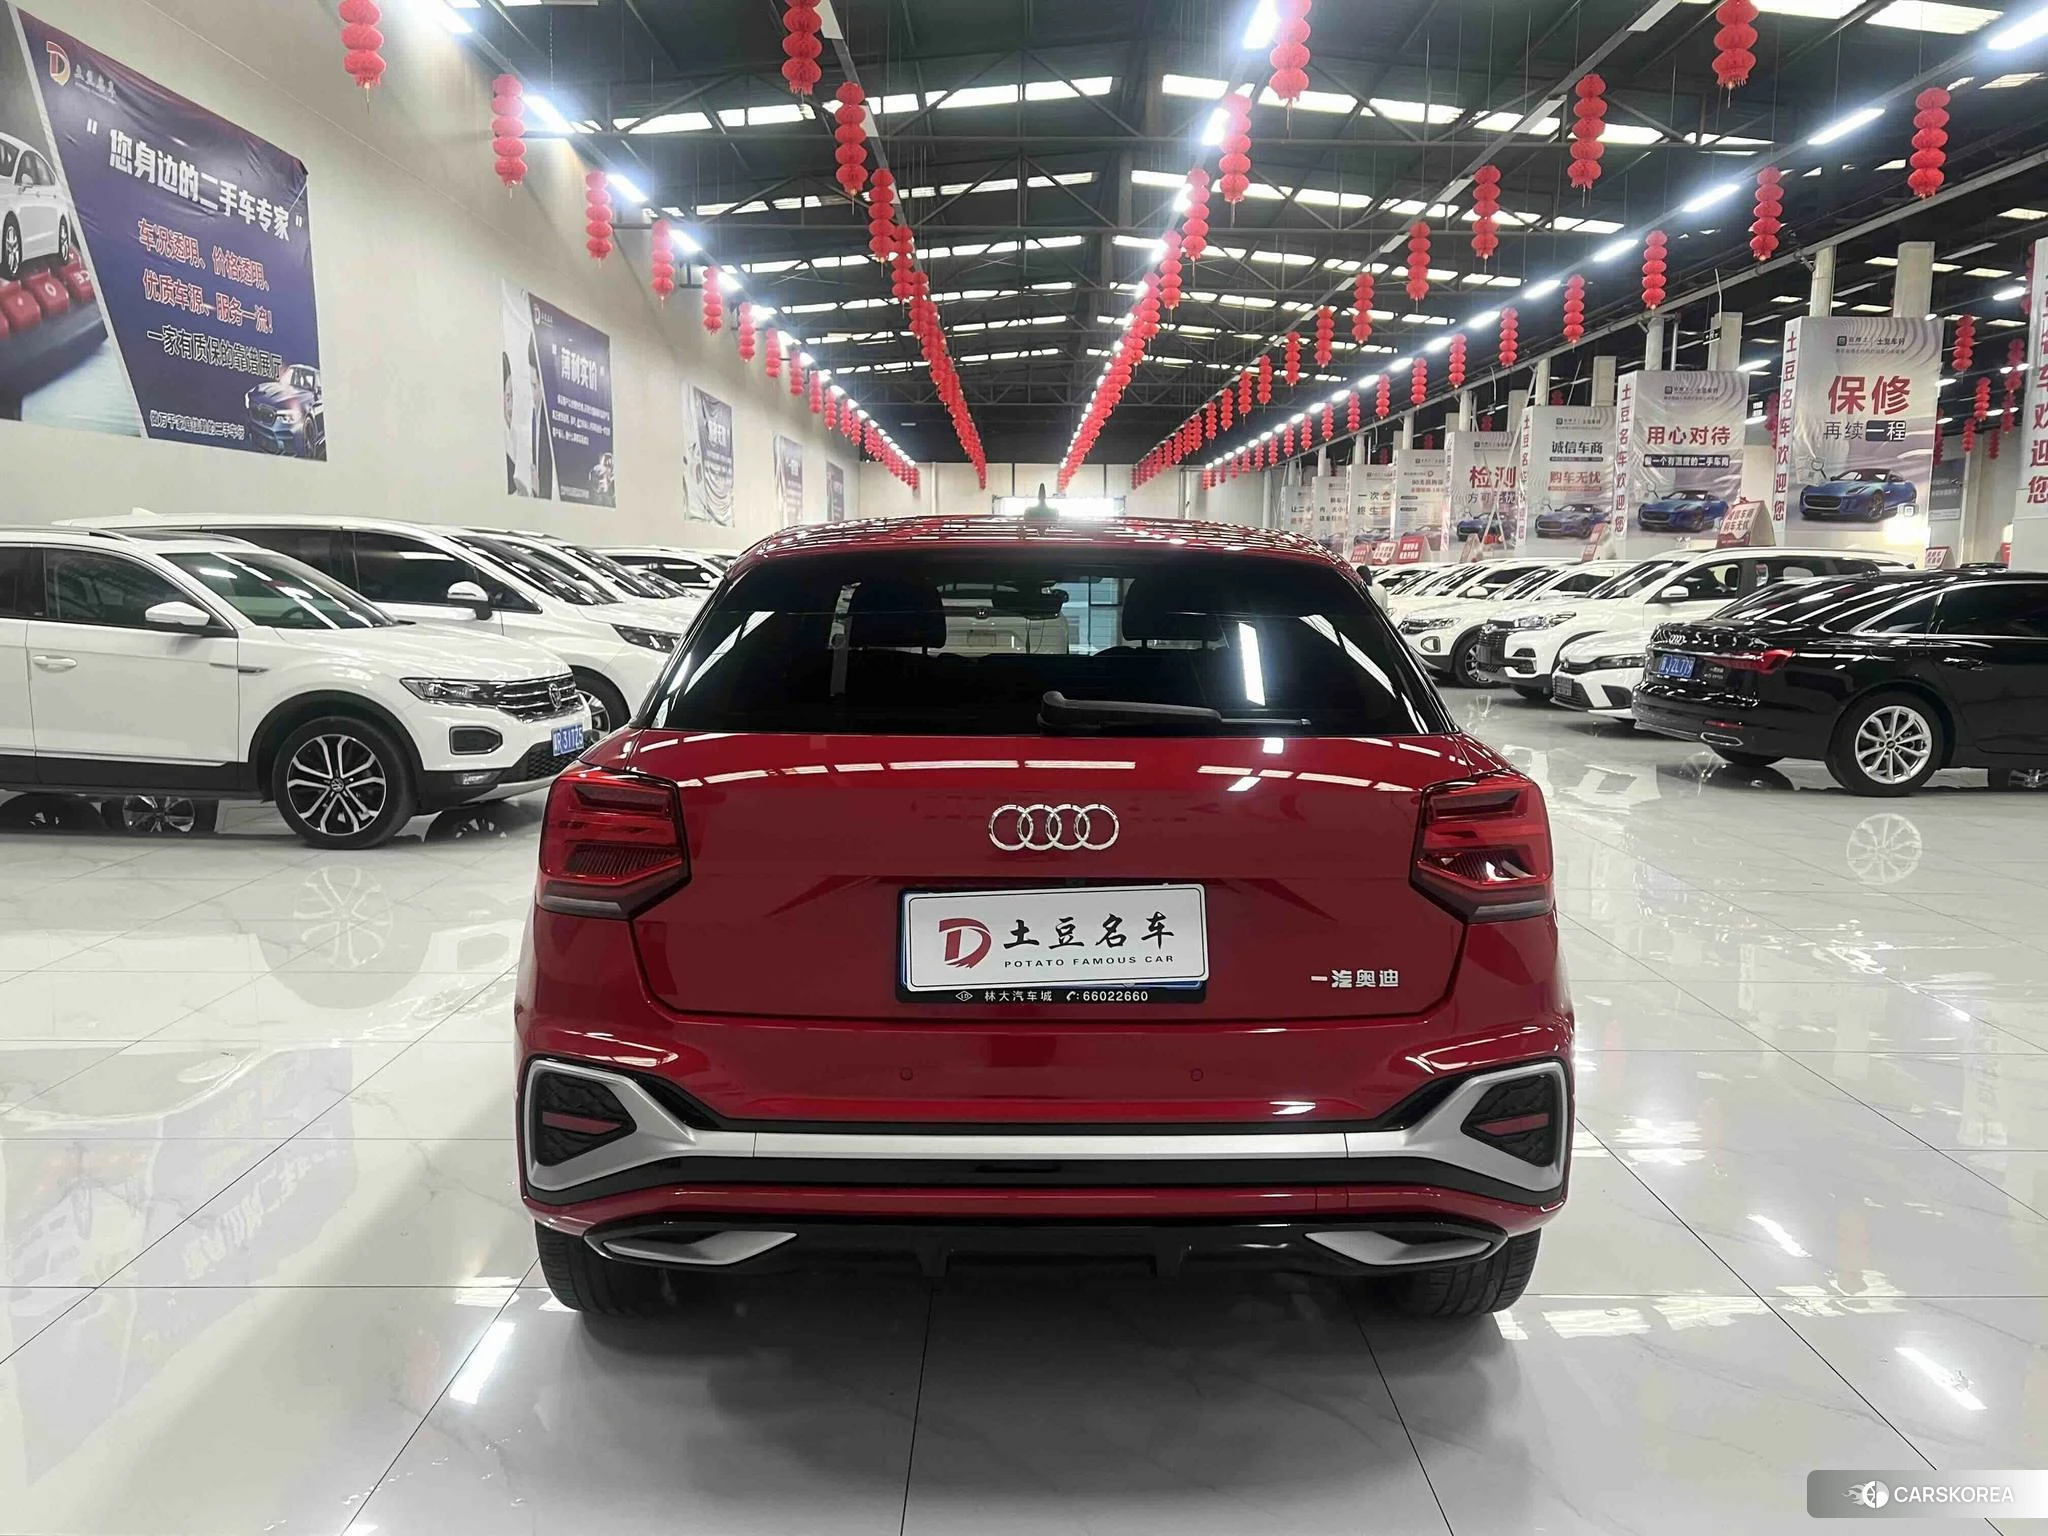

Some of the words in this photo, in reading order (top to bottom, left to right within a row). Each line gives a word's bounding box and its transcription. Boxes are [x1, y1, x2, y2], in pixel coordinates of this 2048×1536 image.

[1827, 375, 1911, 416] 保修
[1647, 426, 1731, 446] 用心对待
[1772, 330, 1797, 522] 土豆名车欢迎您
[1823, 420, 1907, 440] 再续一程
[1551, 441, 1603, 455] 诚信车商
[1613, 383, 1632, 534] 土豆名车欢迎您
[1469, 465, 1517, 489] 检测
[1003, 911, 1174, 950] 土豆名车
[1004, 959, 1064, 968] POTATO
[1073, 956, 1137, 966] FAMOUS
[1145, 955, 1174, 963] CAR
[1311, 969, 1399, 988] 一汽奥迪
[984, 990, 1053, 1002] 林大汽车城
[1082, 991, 1149, 1001] 66022660
